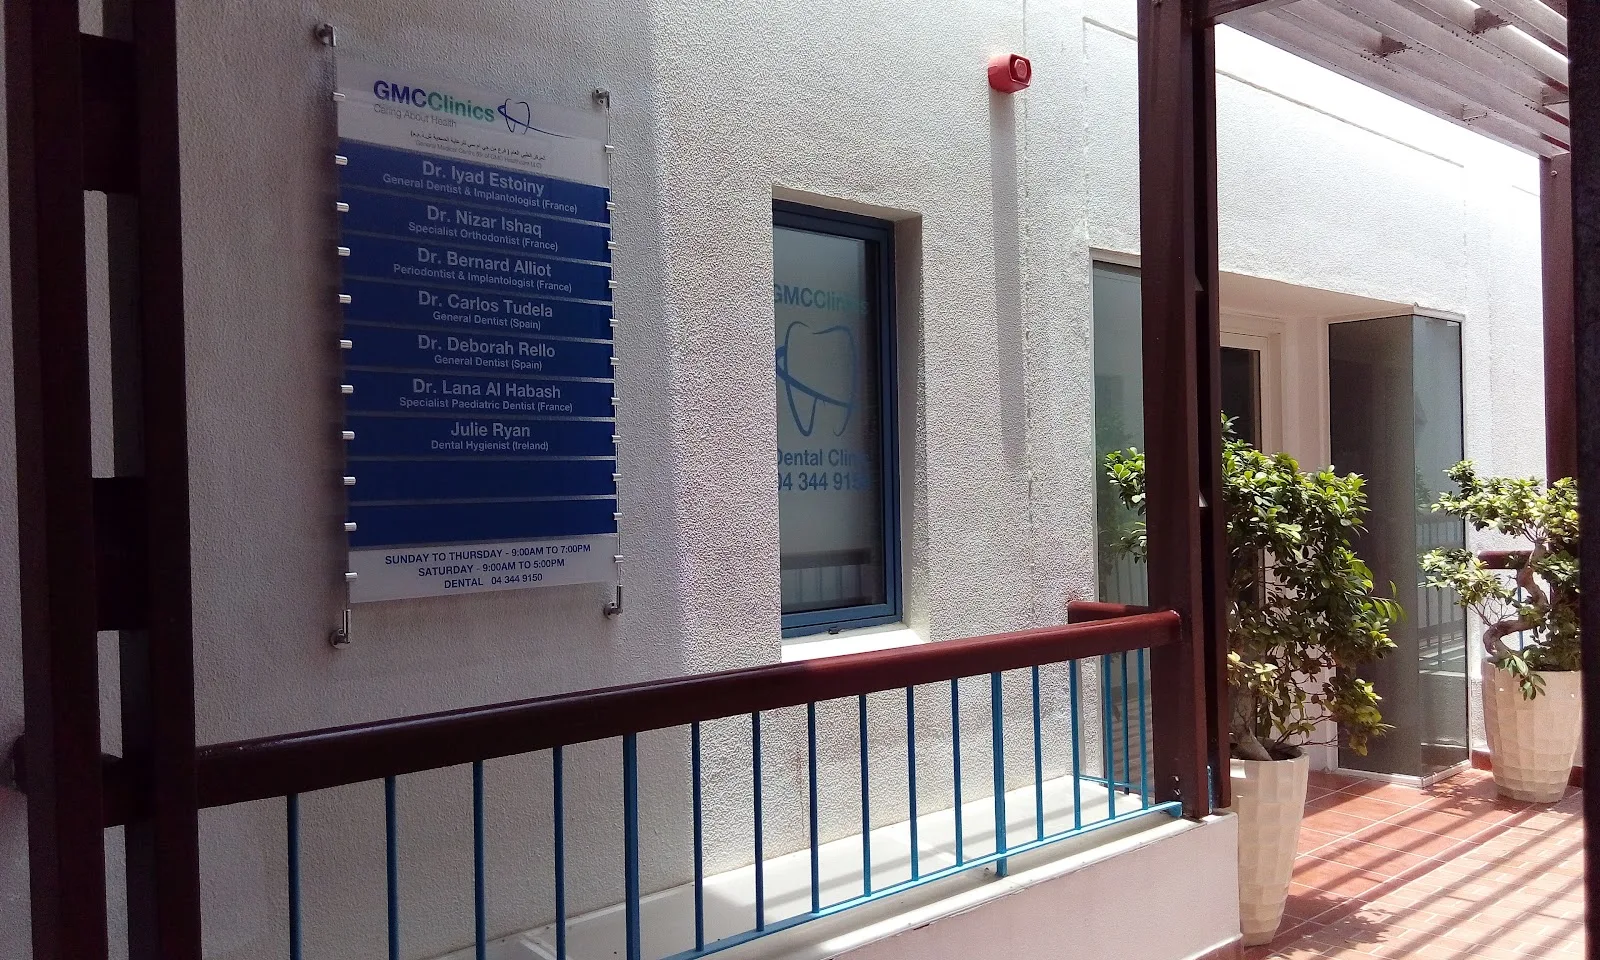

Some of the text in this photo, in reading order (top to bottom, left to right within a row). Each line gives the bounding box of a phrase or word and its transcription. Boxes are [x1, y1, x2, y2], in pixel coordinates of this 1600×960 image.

[374, 80, 495, 122] GMCClinics
[374, 103, 457, 128] Caring About Health
[423, 161, 544, 197] Dr. Iyad Estoiny
[383, 174, 577, 214] General Dentist & Implantologist (France)
[428, 206, 542, 238] Dr. Nizar Ishaq
[409, 222, 558, 252] Specialist Orthodontist (France)
[418, 248, 551, 277] Dr. Bernard Alliot
[394, 264, 571, 293] Periodontist & Implantologist (France)
[419, 291, 553, 317] Dr. Carlos Tudela
[433, 311, 540, 330] General Dentist (Spain)
[418, 335, 555, 358] Dr. Deborah Rello
[435, 355, 542, 371] General Dentist (Spain)
[413, 378, 561, 398] Dr. Lana Al Habash
[400, 397, 572, 413] Specialist Paediatric Dentist (France)
[451, 422, 530, 439] Julie Ryan
[432, 440, 548, 451] Dental Hygienist (Ireland)
[799, 472, 828, 491] 344
[385, 554, 430, 564] SUNDAY
[432, 552, 446, 562] TO
[449, 550, 502, 560] THURSDAY
[512, 546, 544, 557] 9:00AM
[546, 546, 558, 554] TO
[560, 544, 591, 554] 7:00PM
[418, 565, 473, 576] SATURDAY
[483, 562, 516, 572] 9:00AM
[518, 560, 531, 570] TO
[534, 559, 565, 569] 5:00PM
[444, 573, 543, 588] DENTAL 04 344 9150
